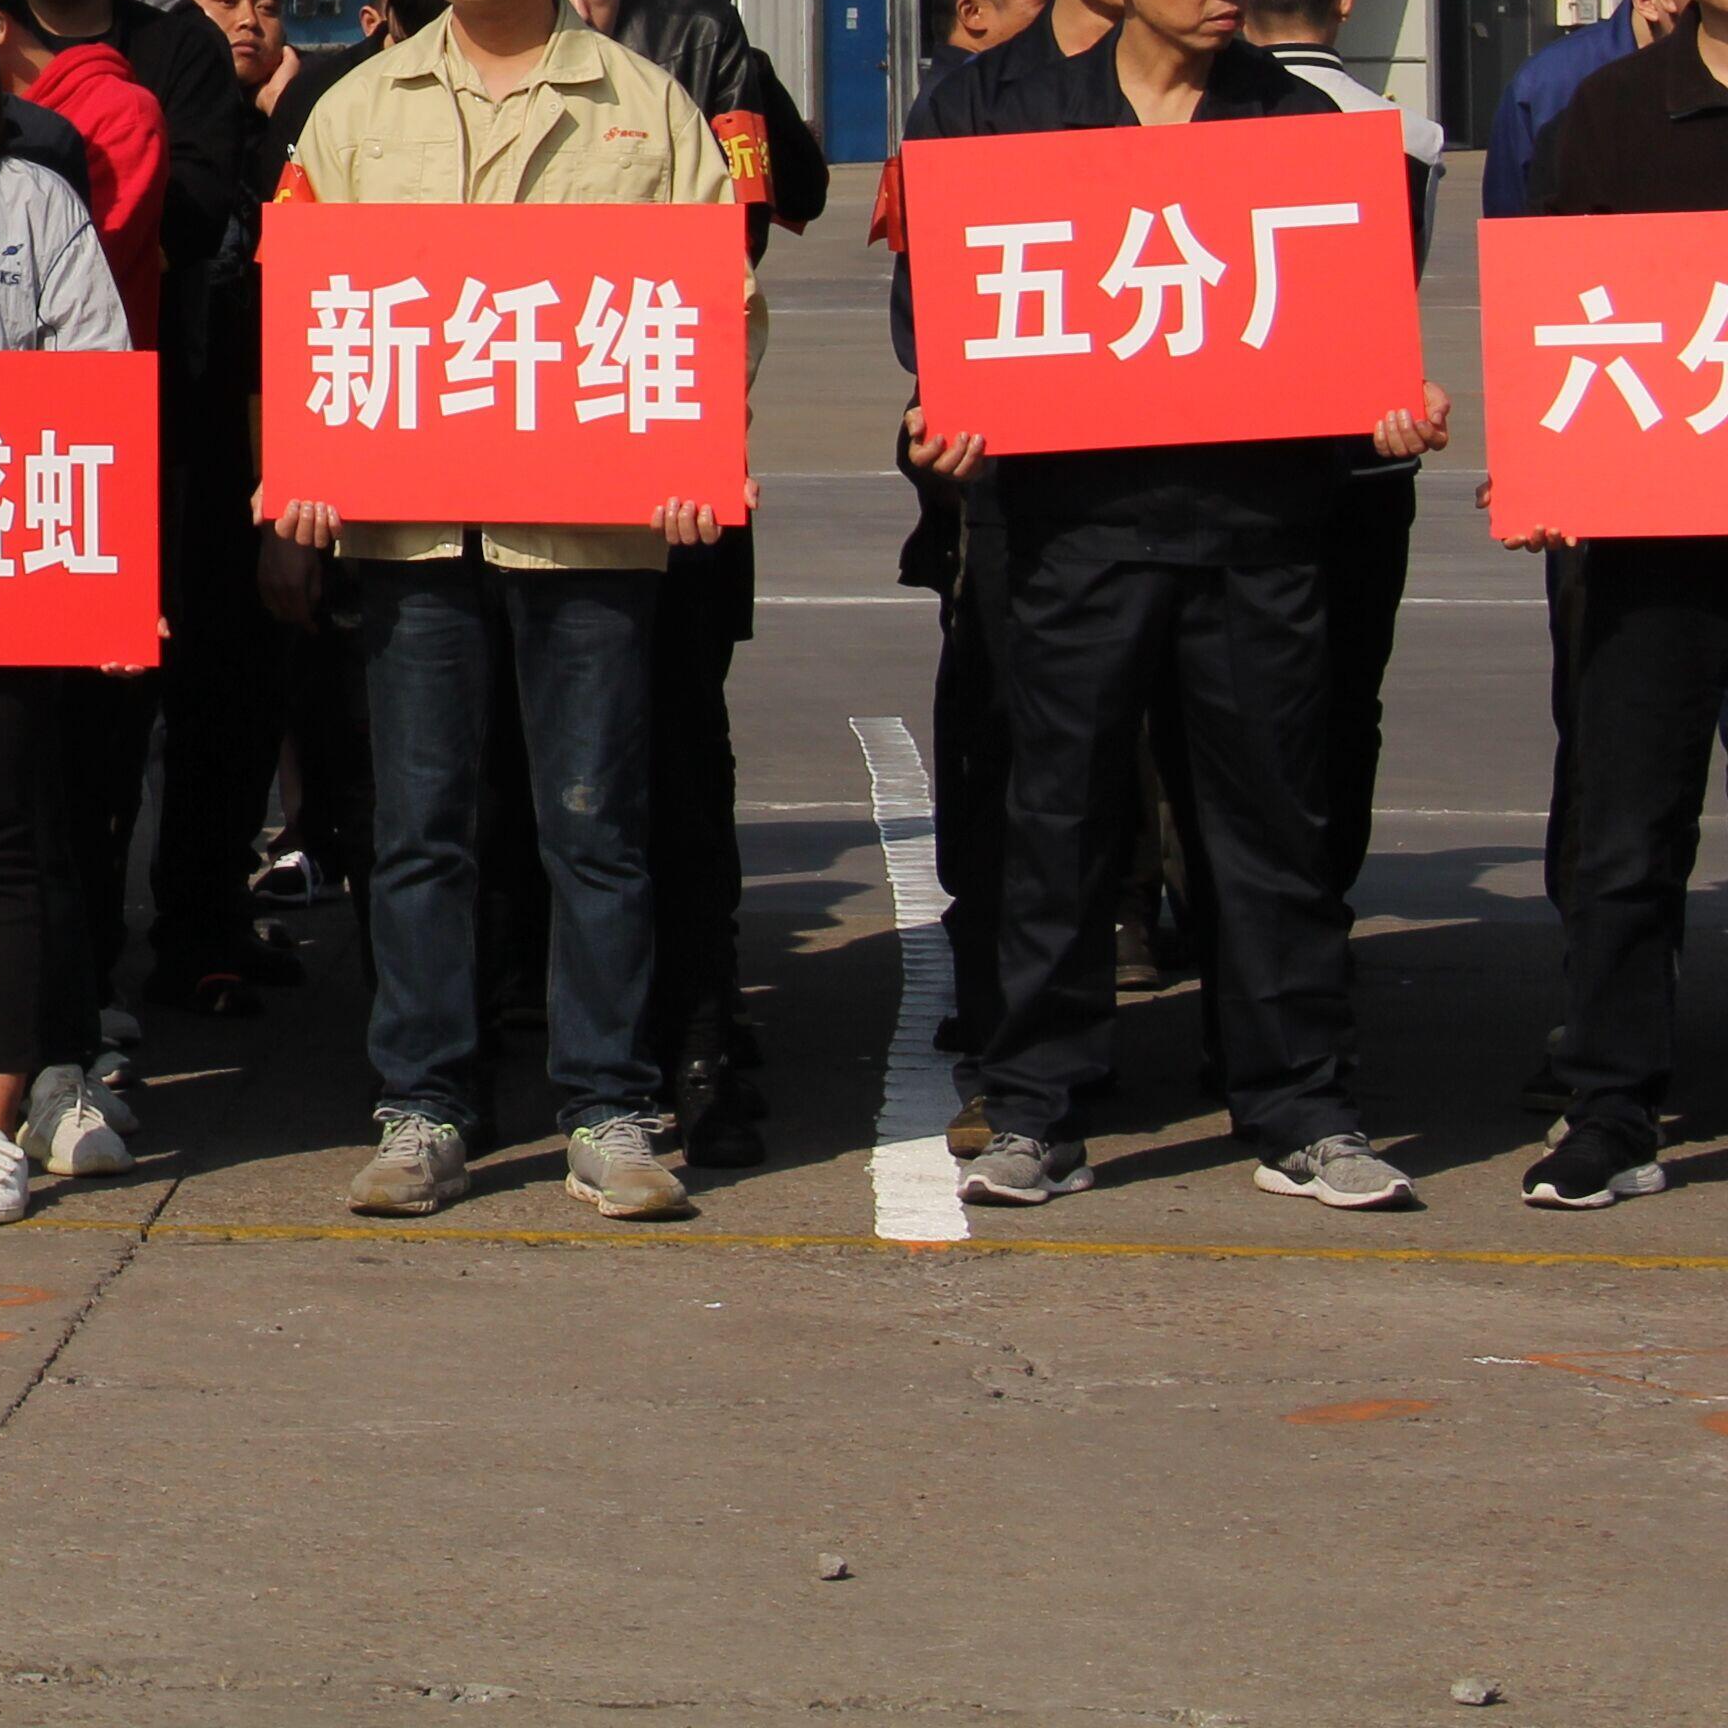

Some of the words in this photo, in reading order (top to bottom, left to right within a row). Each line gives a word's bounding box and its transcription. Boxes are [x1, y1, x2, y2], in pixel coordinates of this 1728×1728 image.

[306, 274, 701, 433] 新纤维
[965, 203, 1359, 360] 五分厂
